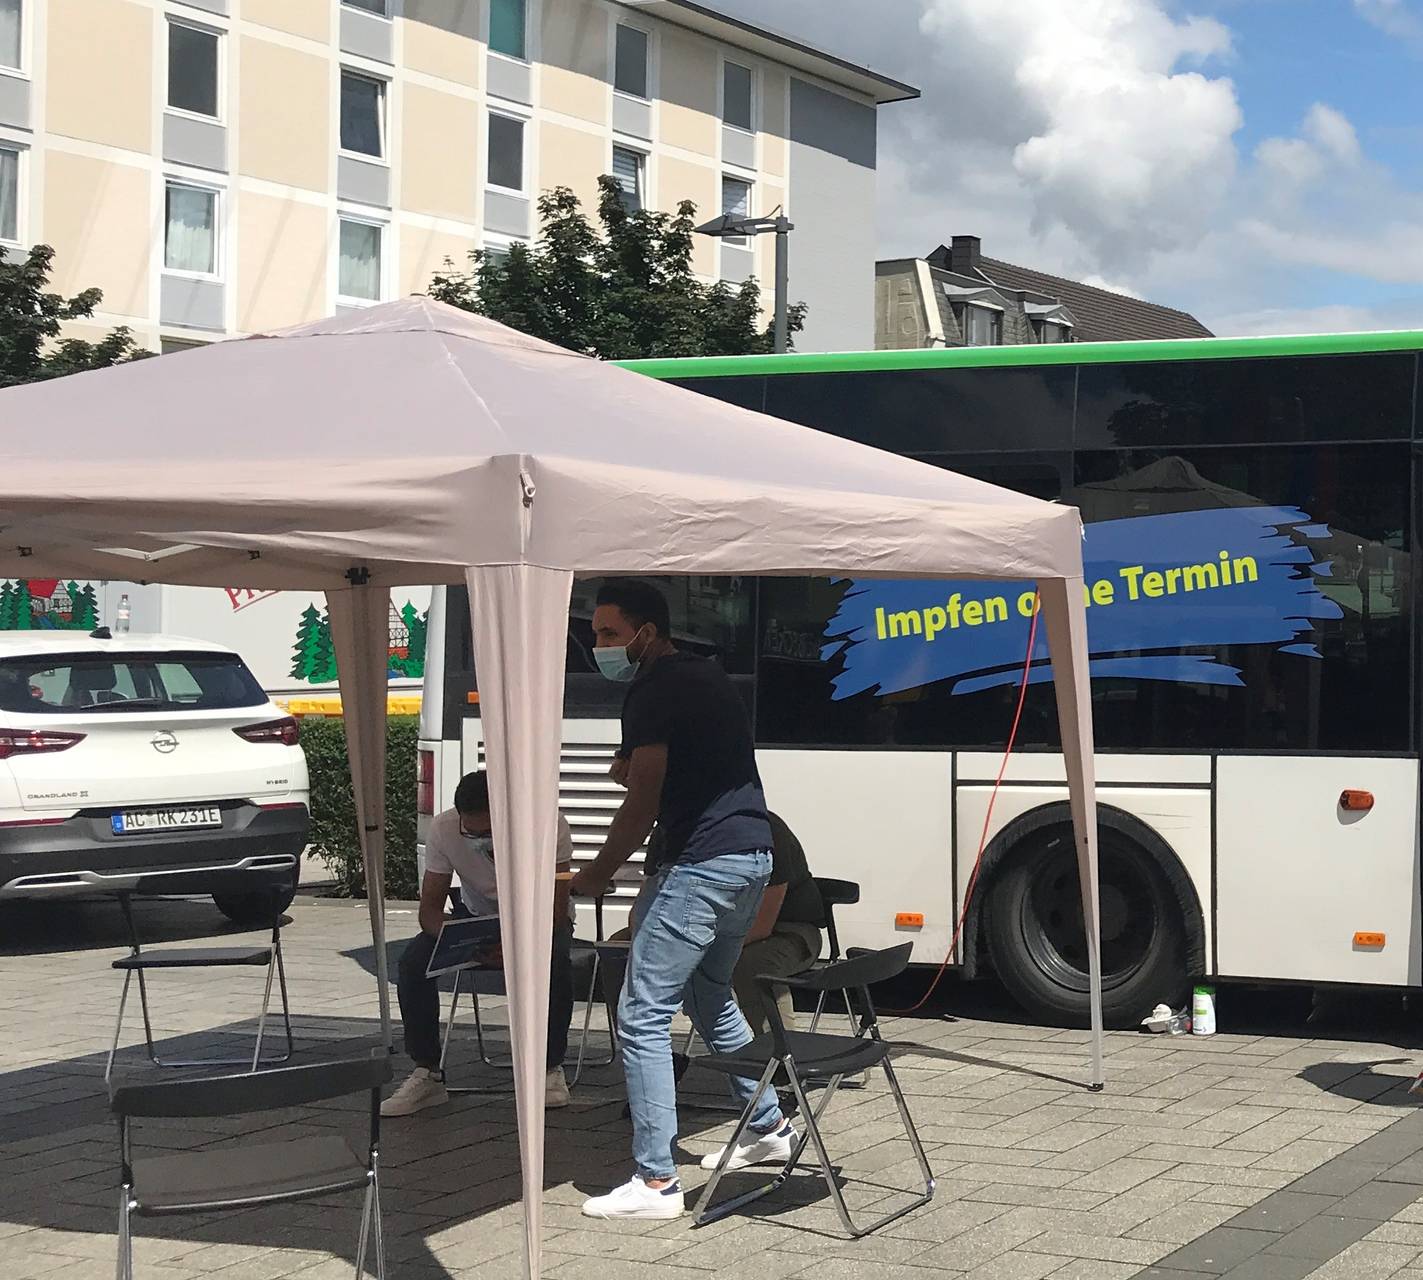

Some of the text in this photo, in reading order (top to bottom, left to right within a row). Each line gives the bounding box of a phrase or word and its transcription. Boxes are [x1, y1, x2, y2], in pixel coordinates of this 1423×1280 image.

[874, 550, 1259, 642] Impfen oe Termin
[125, 811, 146, 828] AC
